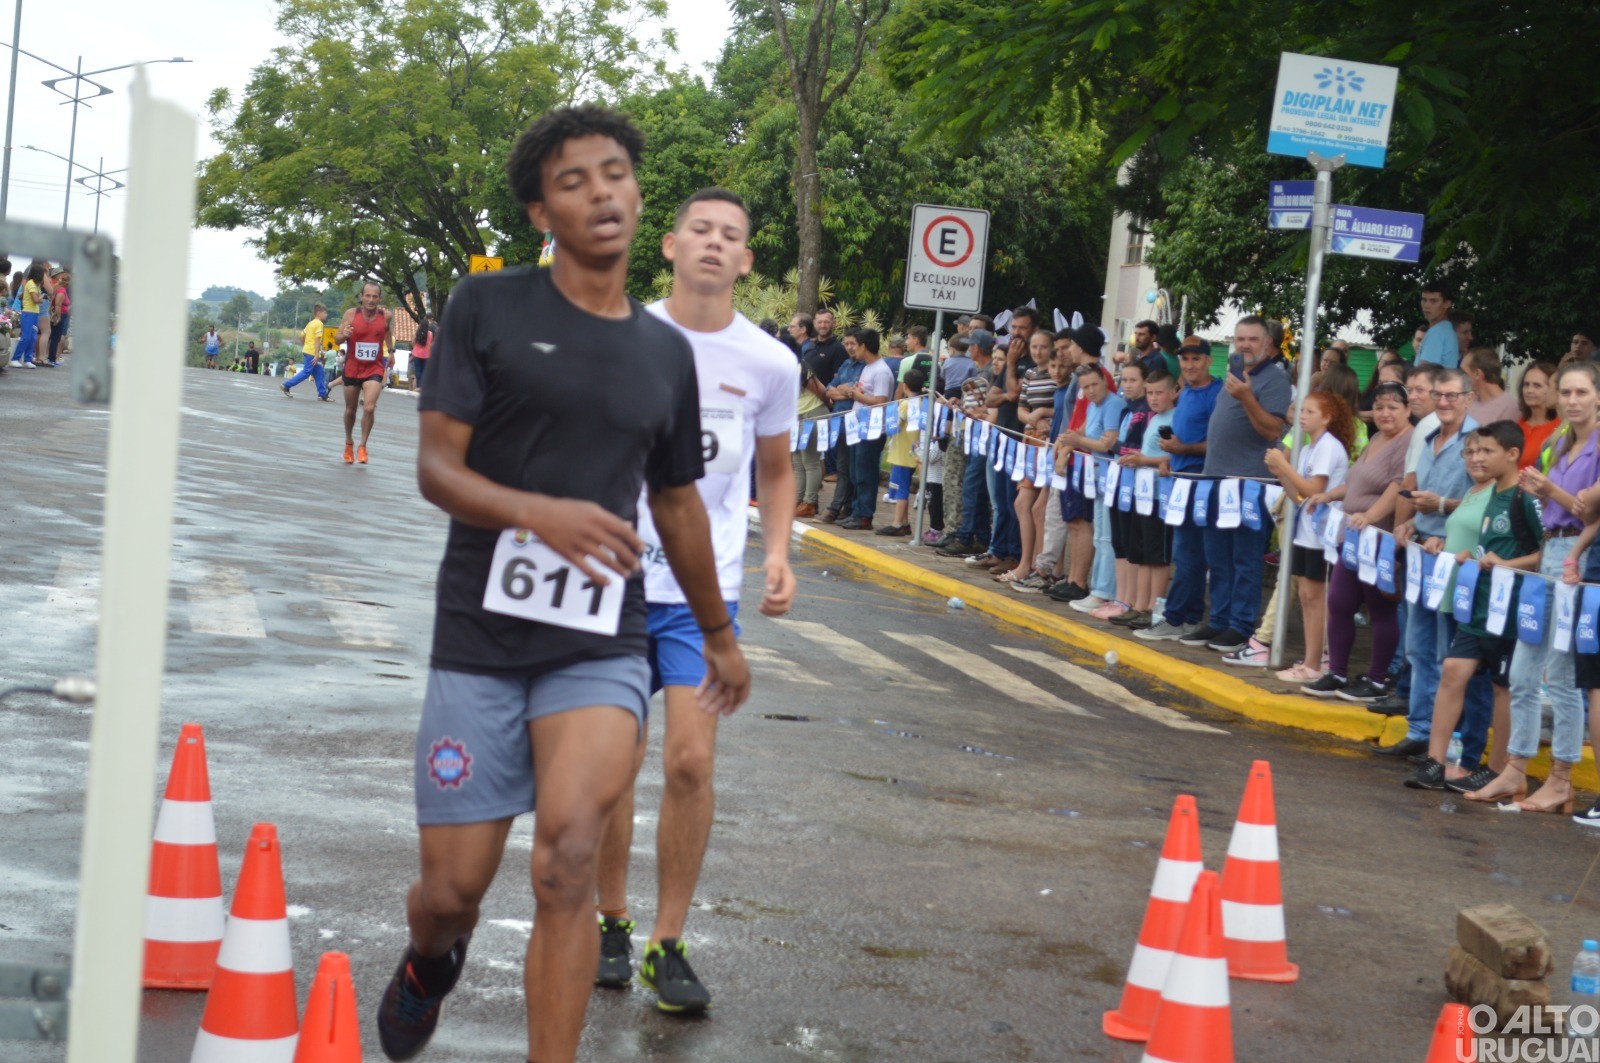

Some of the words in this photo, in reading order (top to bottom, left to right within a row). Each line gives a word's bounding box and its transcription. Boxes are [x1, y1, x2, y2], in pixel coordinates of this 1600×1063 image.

[1282, 90, 1355, 115] DIGIPLAN
[1358, 101, 1388, 120] NET
[1280, 106, 1316, 118] PROVEDOR
[1317, 112, 1336, 120] LEGAL
[1350, 116, 1381, 127] INTERNET
[1305, 120, 1322, 128] 0800
[1336, 208, 1352, 218] RUA
[1335, 219, 1349, 232] DR.
[1351, 218, 1382, 236] ÁLVARO
[1384, 224, 1414, 240] LEITÃO
[939, 228, 958, 255] E
[913, 272, 976, 288] EXCLUSIVO
[932, 286, 956, 300] TÁXI
[357, 349, 377, 358] 518
[501, 556, 605, 617] 611
